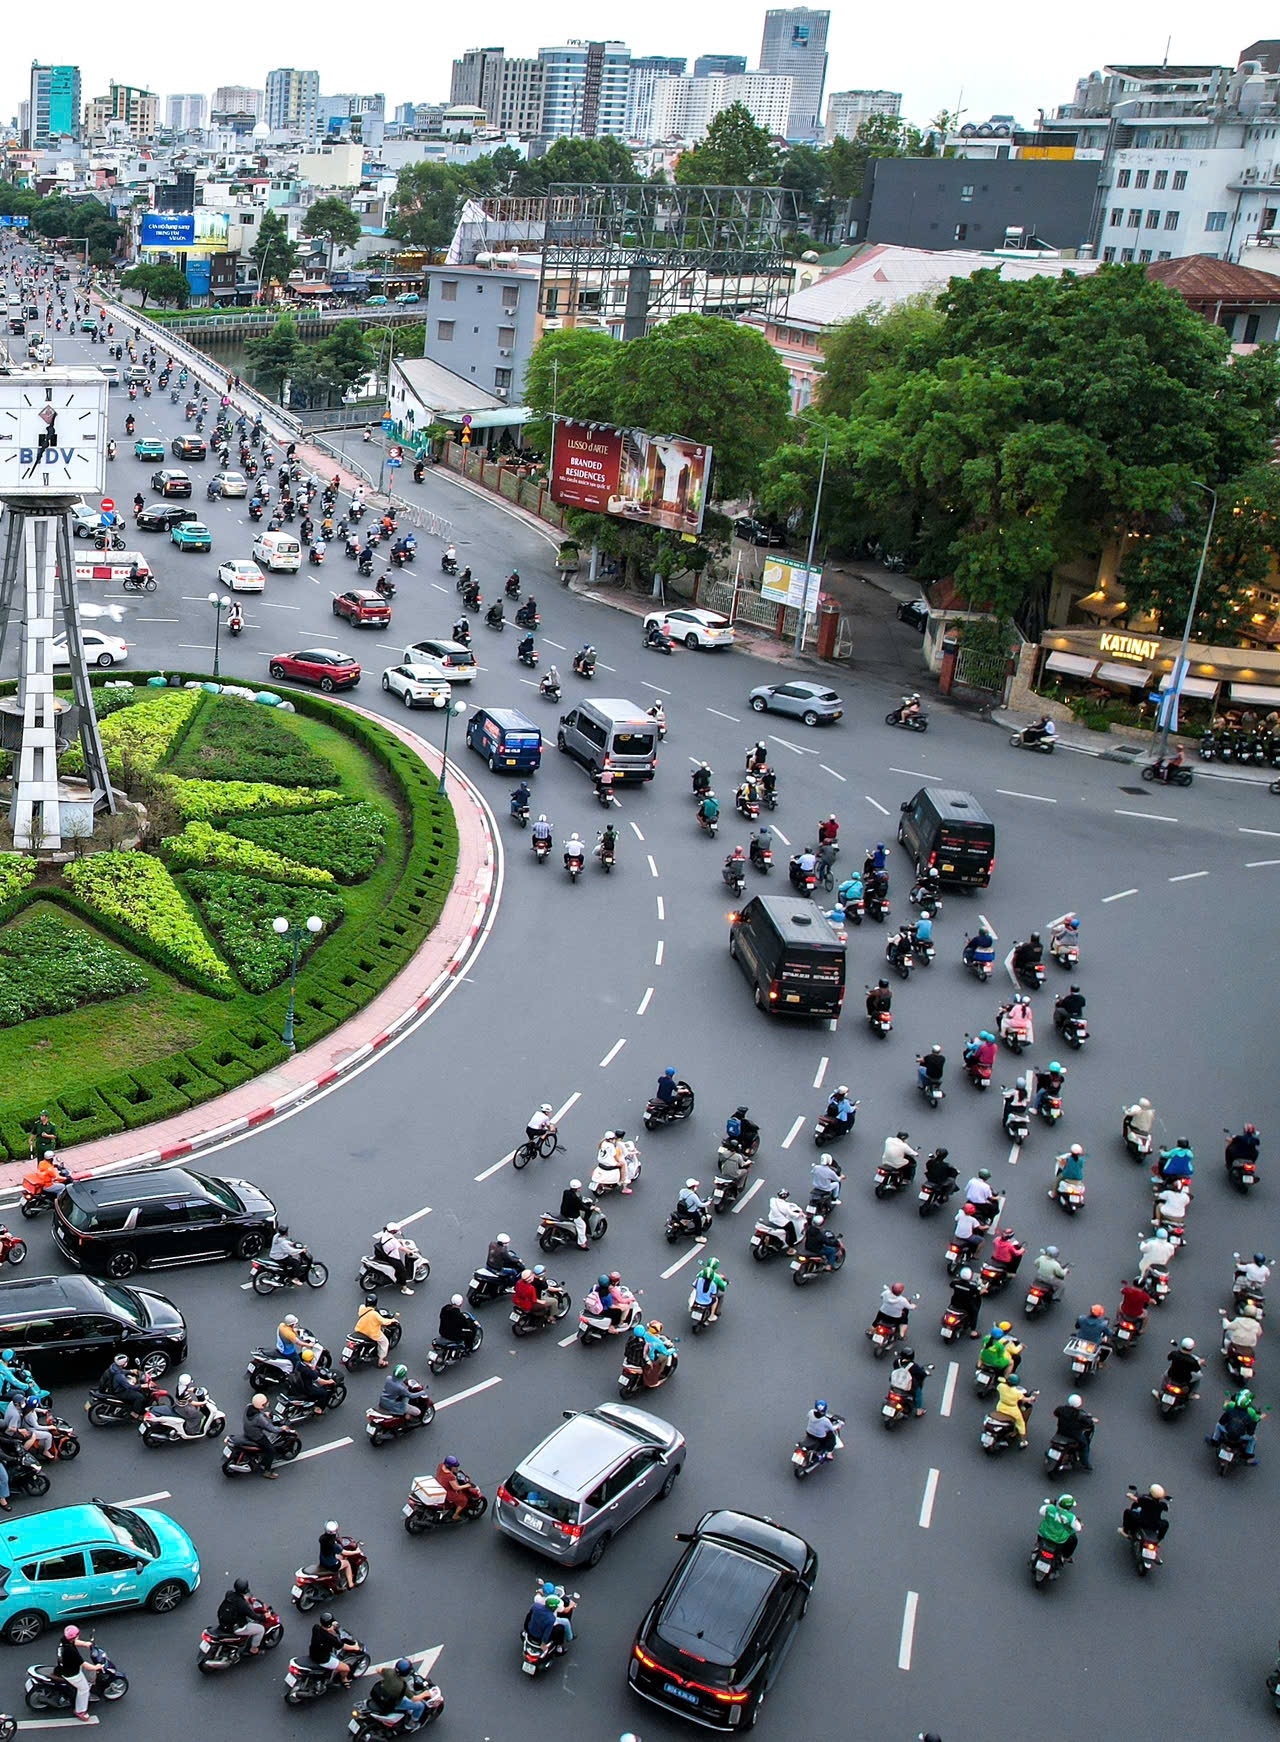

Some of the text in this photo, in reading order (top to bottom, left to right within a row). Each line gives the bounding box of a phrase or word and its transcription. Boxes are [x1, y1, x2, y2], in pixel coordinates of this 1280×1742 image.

[567, 438, 588, 451] LUSSO
[19, 447, 75, 465] BIDV
[570, 456, 603, 470] BRANDED
[565, 467, 606, 483] RESIDENCES
[1099, 632, 1160, 660] KATINAT
